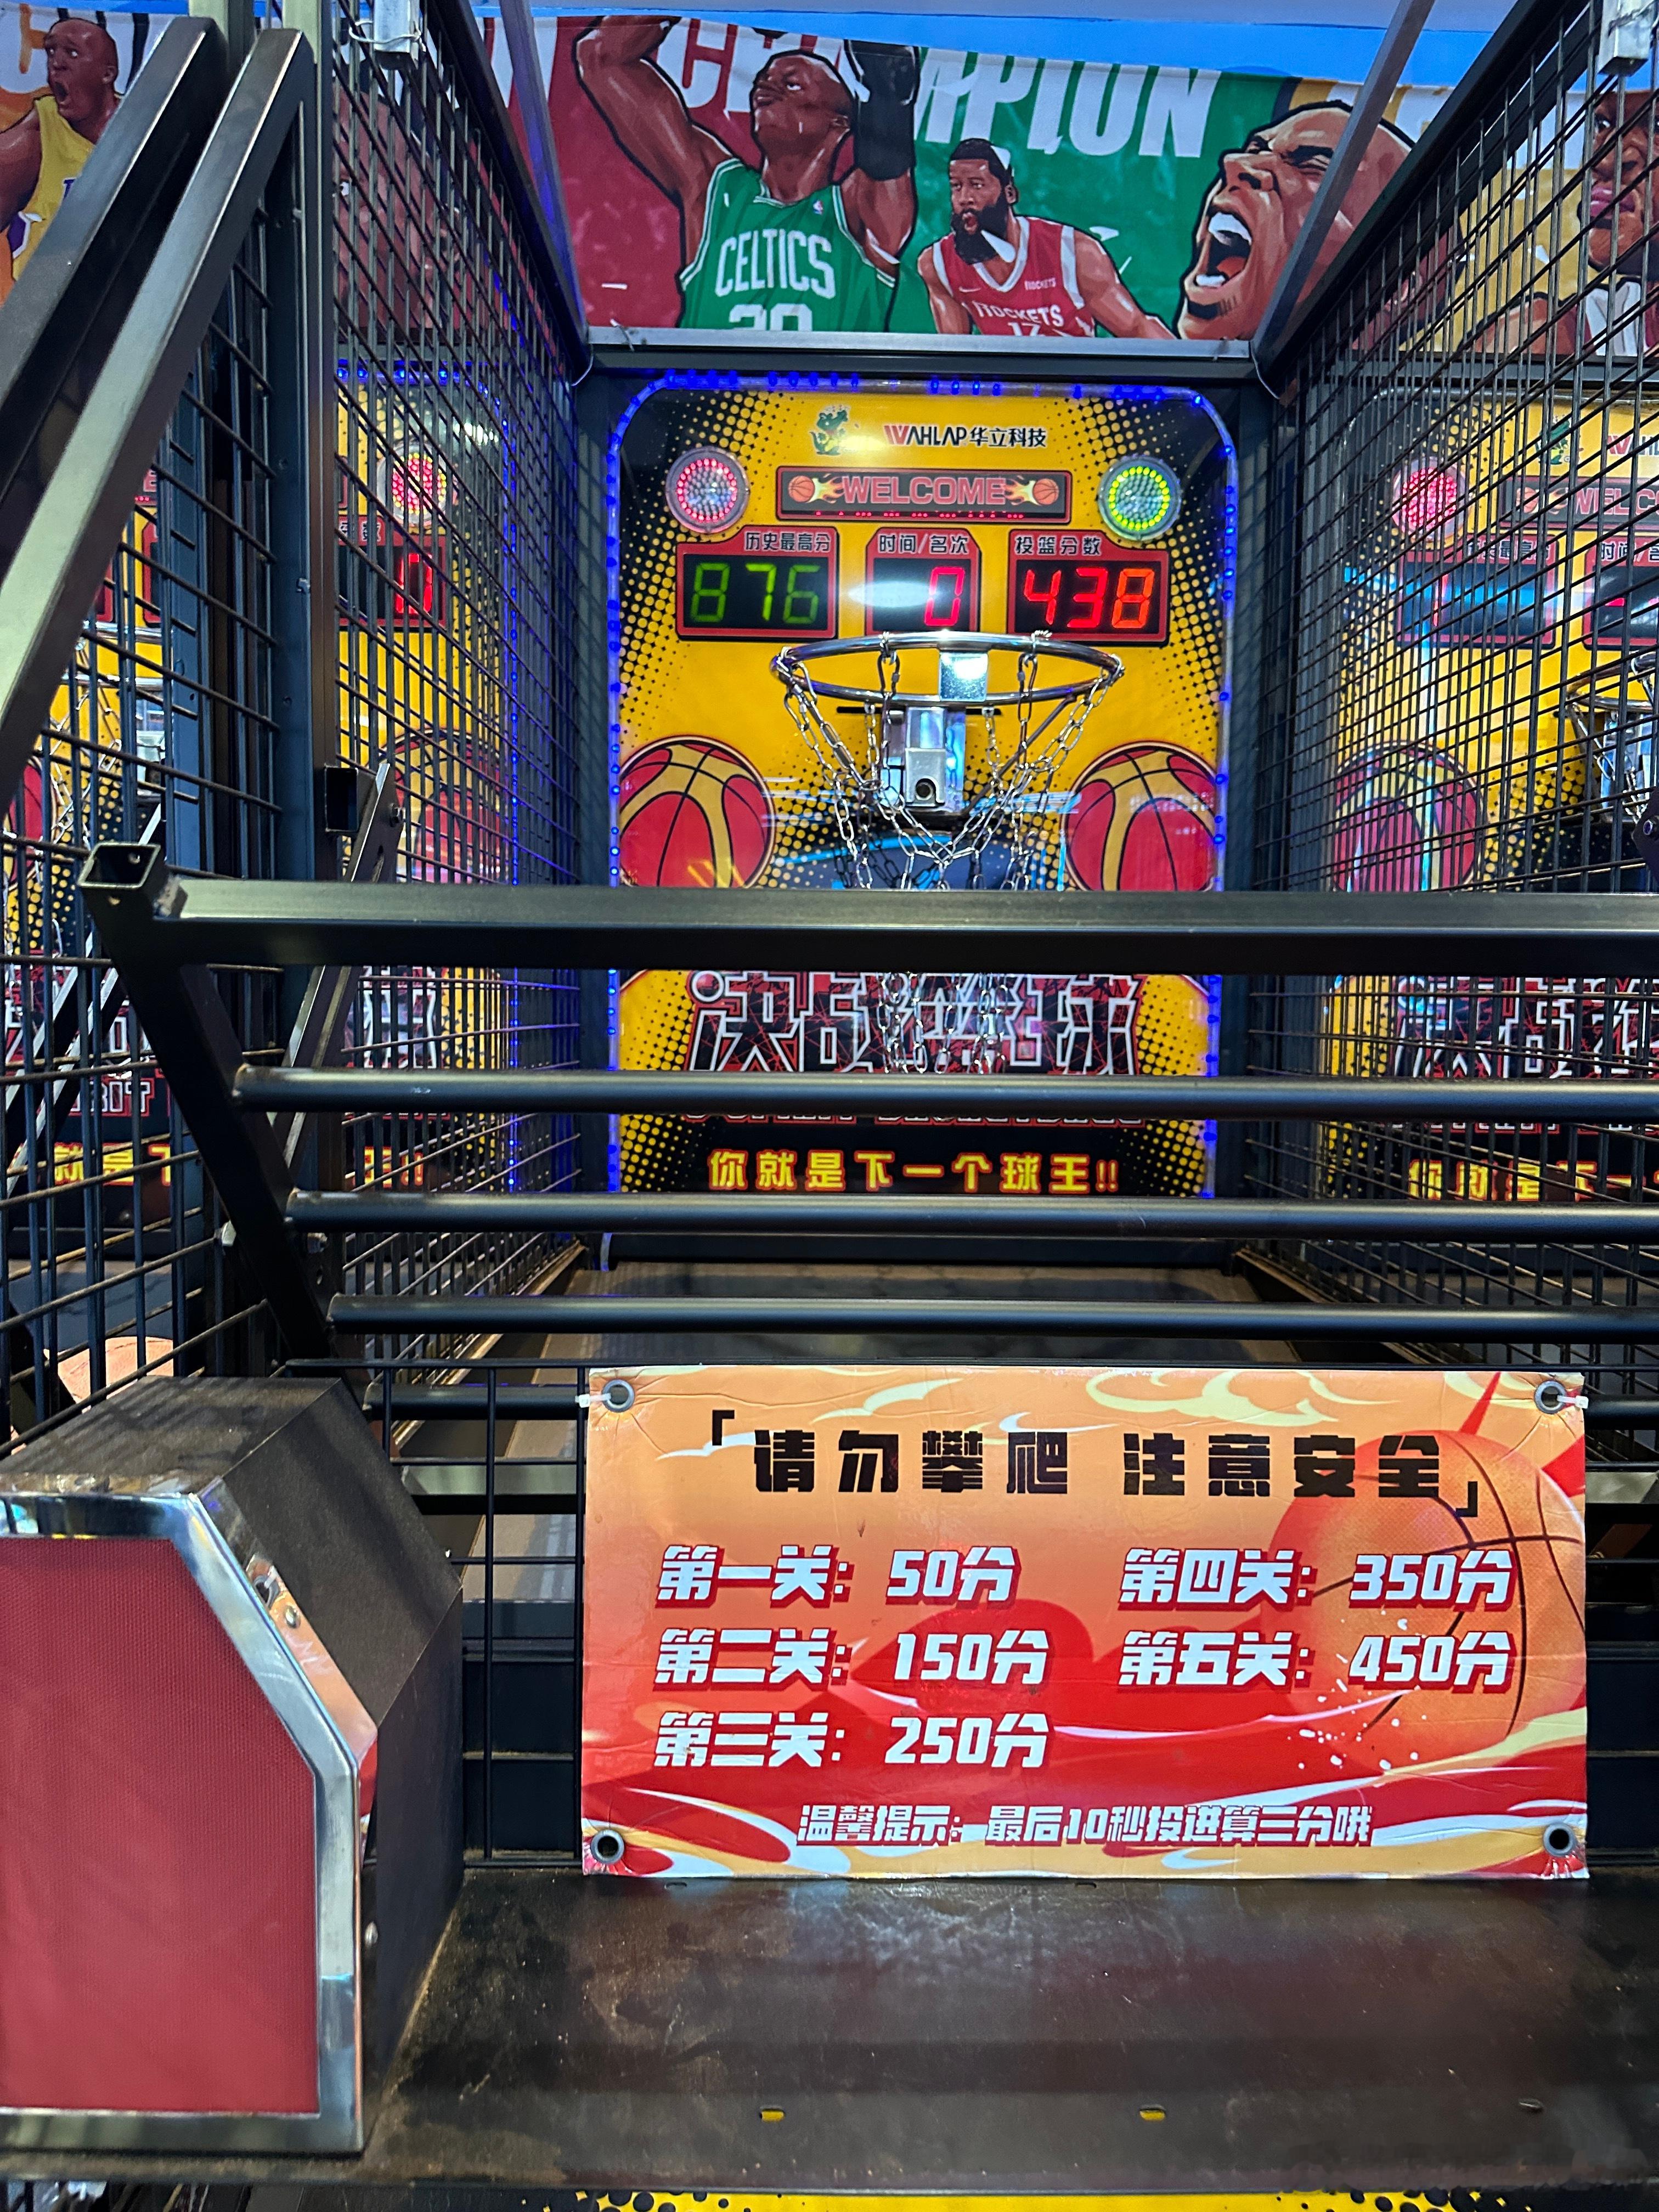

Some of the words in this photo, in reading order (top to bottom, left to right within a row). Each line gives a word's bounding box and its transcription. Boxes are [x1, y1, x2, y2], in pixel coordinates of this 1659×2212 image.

[715, 228, 837, 299] CELTICS
[972, 300, 1064, 327] ROCKETS
[841, 476, 1007, 505] WELCOME
[743, 531, 832, 552] 历史最高分
[1014, 534, 1103, 556] 投篮分数
[690, 562, 821, 624] 876
[923, 566, 966, 627] 0
[1023, 566, 1155, 629] 438
